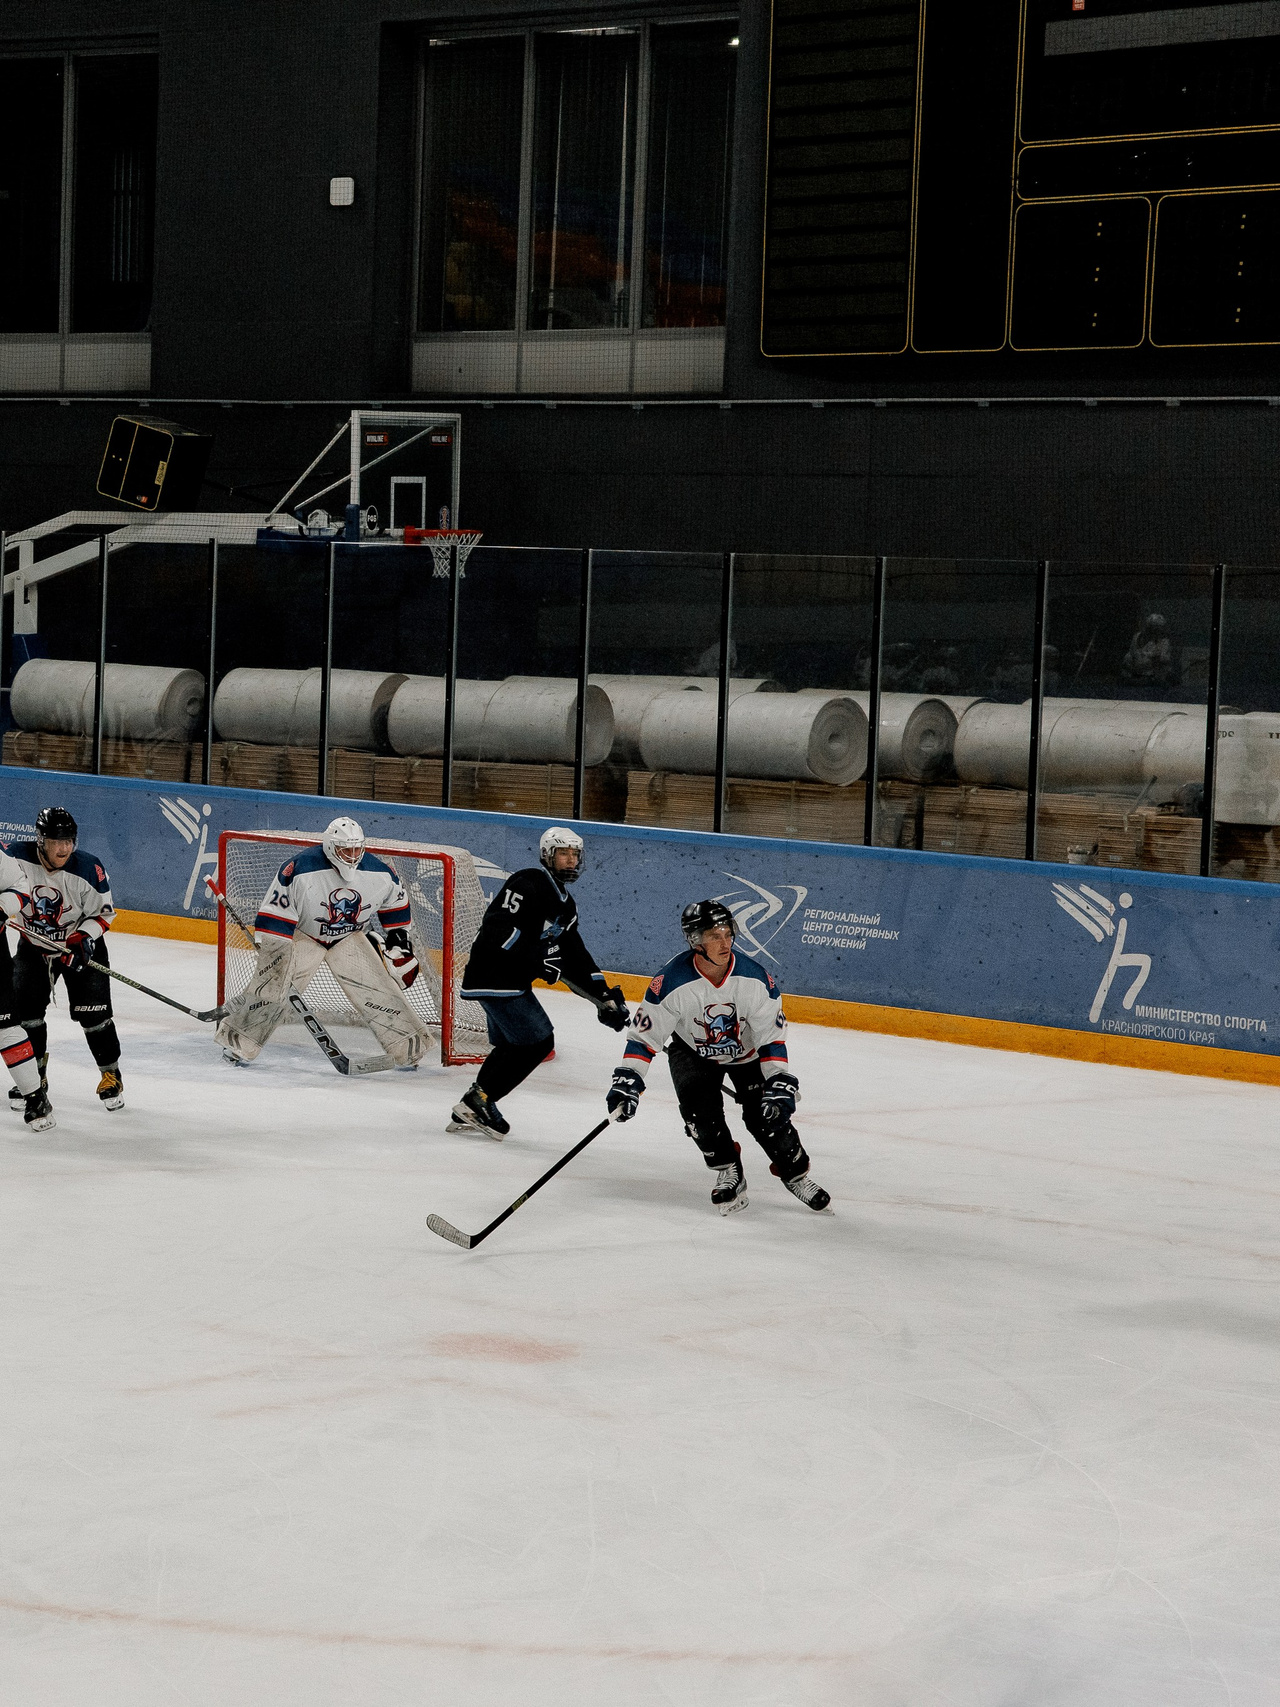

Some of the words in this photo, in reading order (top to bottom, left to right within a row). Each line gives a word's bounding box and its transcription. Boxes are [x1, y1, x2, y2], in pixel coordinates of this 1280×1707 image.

[269, 889, 290, 909] 20
[501, 889, 523, 914] 15
[804, 908, 881, 925] РЕГИОНАЛЬНЫЙ
[803, 922, 833, 934] ЦЕНТР
[835, 925, 899, 940] СПОРТИВНЫХ
[801, 934, 866, 950] СООРУЖЕНИЙ
[259, 955, 282, 977] BAUER
[73, 1003, 107, 1012] BAUER
[364, 1001, 402, 1016] BAUER
[289, 994, 340, 1058] CCM
[1135, 1005, 1221, 1026] МИНИСТЕРСТВО
[1224, 1016, 1267, 1032] СПОРТА
[1102, 1019, 1186, 1041] КРАСНОЯРСКОГО
[1188, 1030, 1215, 1044] КРАЯ
